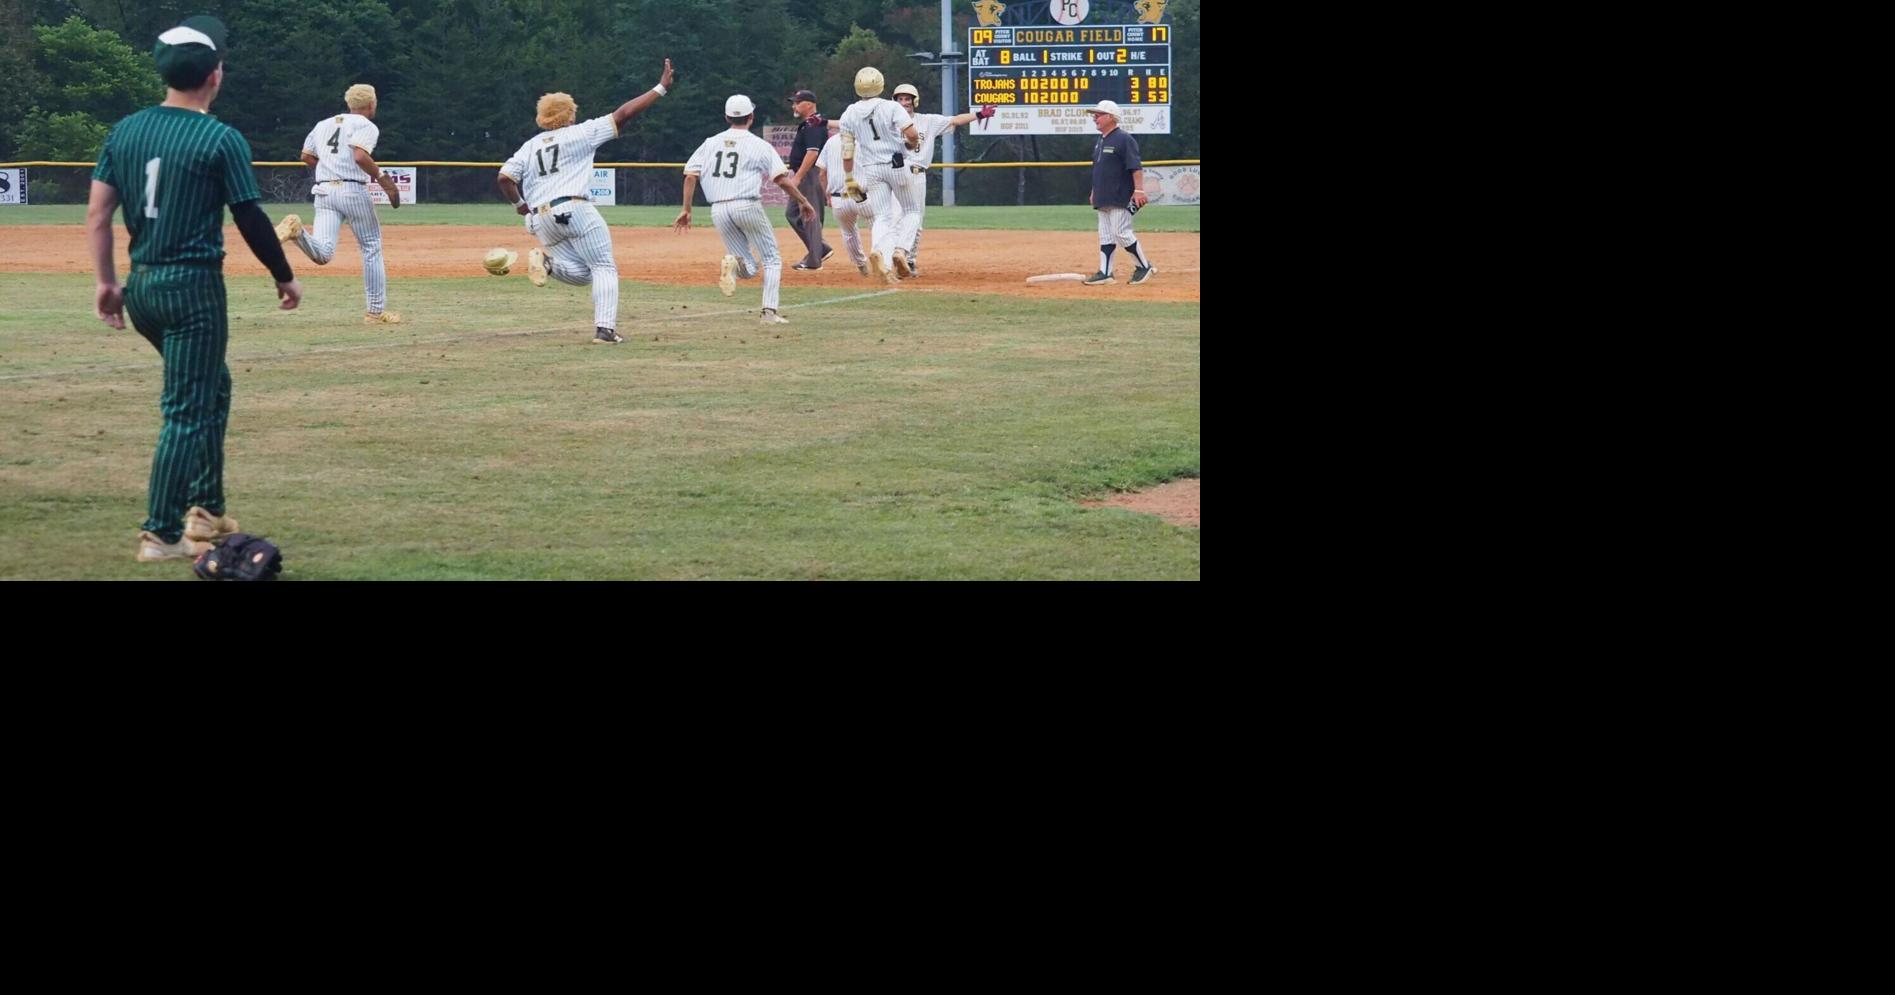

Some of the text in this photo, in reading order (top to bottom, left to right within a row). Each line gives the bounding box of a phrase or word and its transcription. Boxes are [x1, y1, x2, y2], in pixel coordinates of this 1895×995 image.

[1016, 29, 1122, 43] COUGAR FIELD
[1152, 27, 1166, 41] 17
[972, 57, 989, 65] BAT
[1000, 50, 1010, 64] 8
[1013, 53, 1036, 62] BALL
[1050, 52, 1083, 61] STRIKE
[1097, 51, 1115, 60] OUT
[1117, 49, 1126, 63] 2
[1130, 51, 1146, 60] H/E
[974, 79, 1015, 89] TROJANS
[1131, 77, 1139, 88] 3
[974, 93, 1015, 103] COUGARS
[1131, 91, 1139, 102] 3
[1038, 108, 1062, 117] BRAD
[869, 118, 881, 141] 1
[327, 127, 341, 154] 4
[536, 143, 559, 176] 17
[712, 150, 739, 178] 13
[594, 170, 608, 178] AIR
[144, 157, 161, 218] 1
